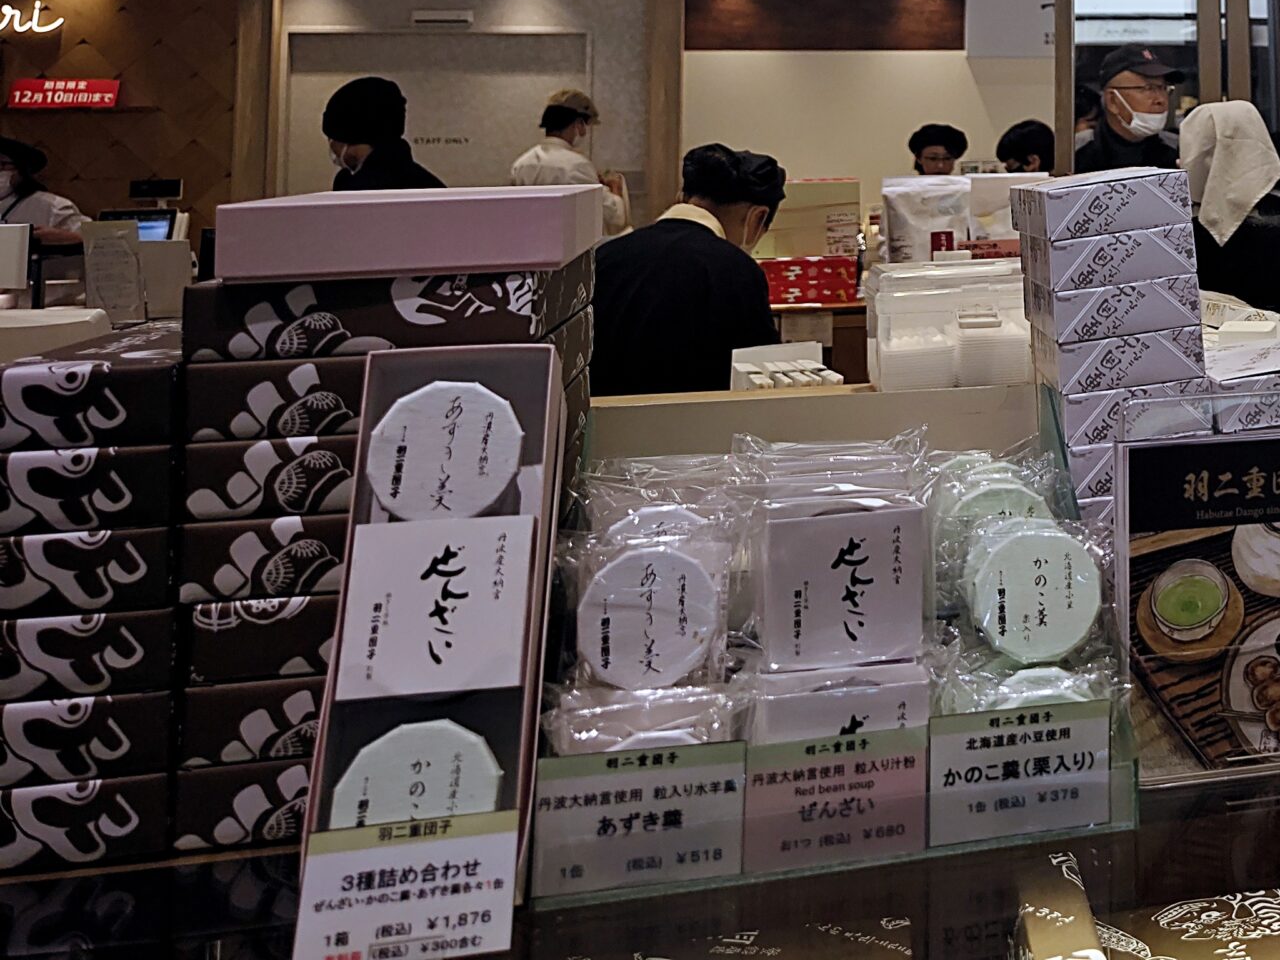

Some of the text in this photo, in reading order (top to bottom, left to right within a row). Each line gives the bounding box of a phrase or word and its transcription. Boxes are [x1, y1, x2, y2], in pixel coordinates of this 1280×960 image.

[1196, 508, 1234, 520] Habutae
[1235, 506, 1264, 518] Dango
[831, 537, 874, 641] ぜんざい
[420, 544, 469, 665] ぜんざい
[966, 727, 1071, 751] 北海道産小豆使用
[538, 788, 643, 812] 丹波大納言使用
[795, 779, 875, 797] Red bean soup
[798, 797, 875, 822] ぜんざい
[379, 820, 452, 841] 羽二重団子
[676, 848, 722, 864] ¥518
[341, 859, 481, 892] 3種詰め合わせ
[324, 910, 492, 946] 1箱 (税込) ¥1,876
